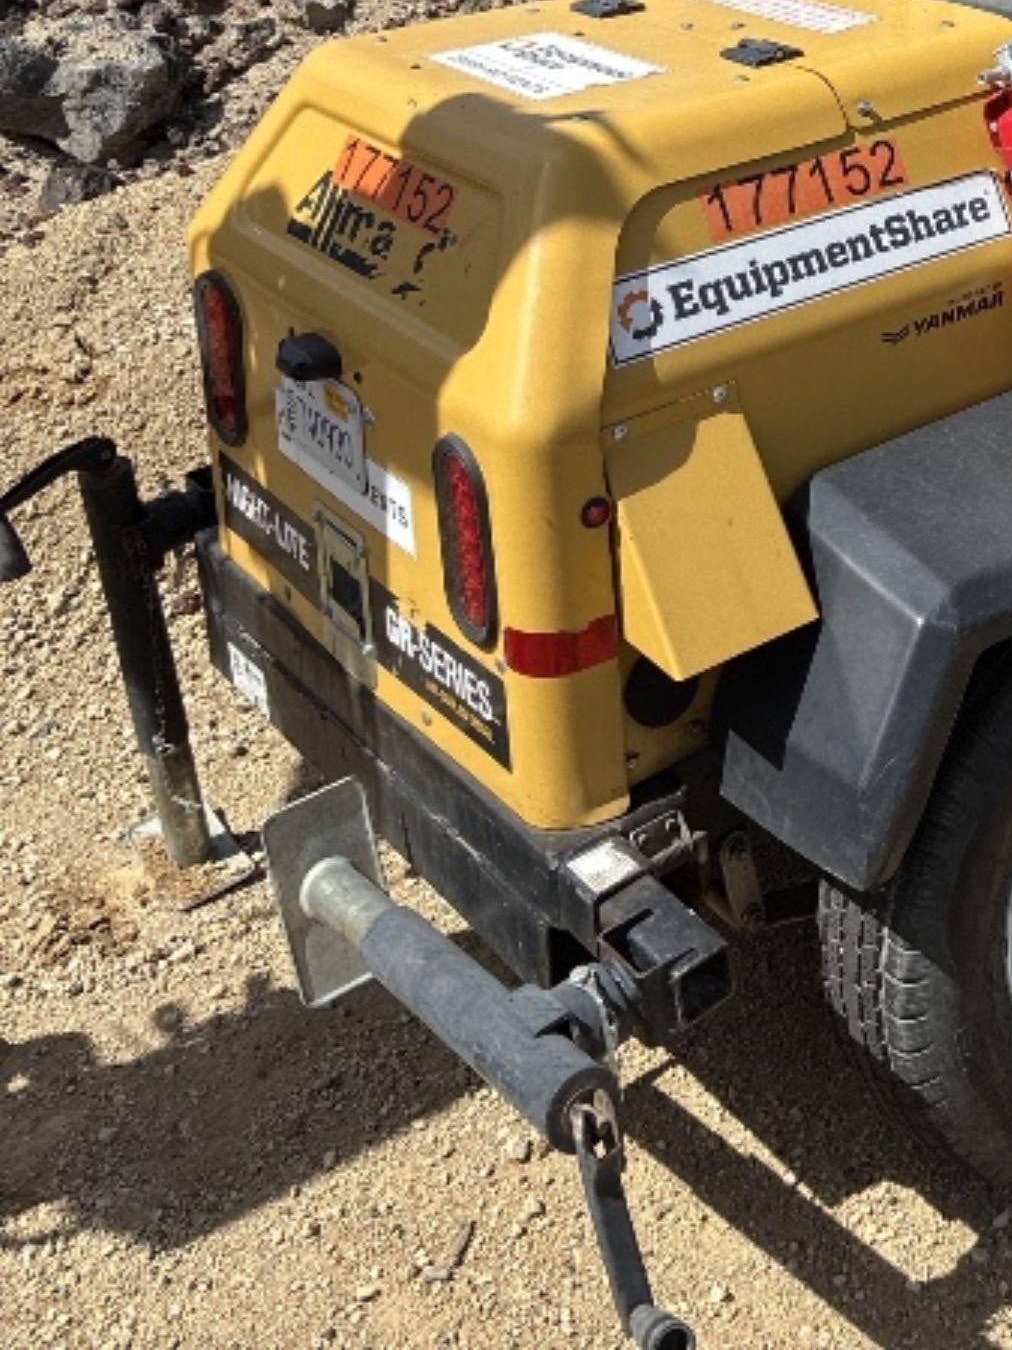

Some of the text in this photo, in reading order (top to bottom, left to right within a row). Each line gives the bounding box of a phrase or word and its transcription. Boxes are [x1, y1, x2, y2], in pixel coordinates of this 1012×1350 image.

[341, 137, 456, 235] 177152
[707, 139, 905, 232] 177152
[666, 196, 992, 322] EquipmentShare
[385, 605, 493, 722] GR-SERIES
